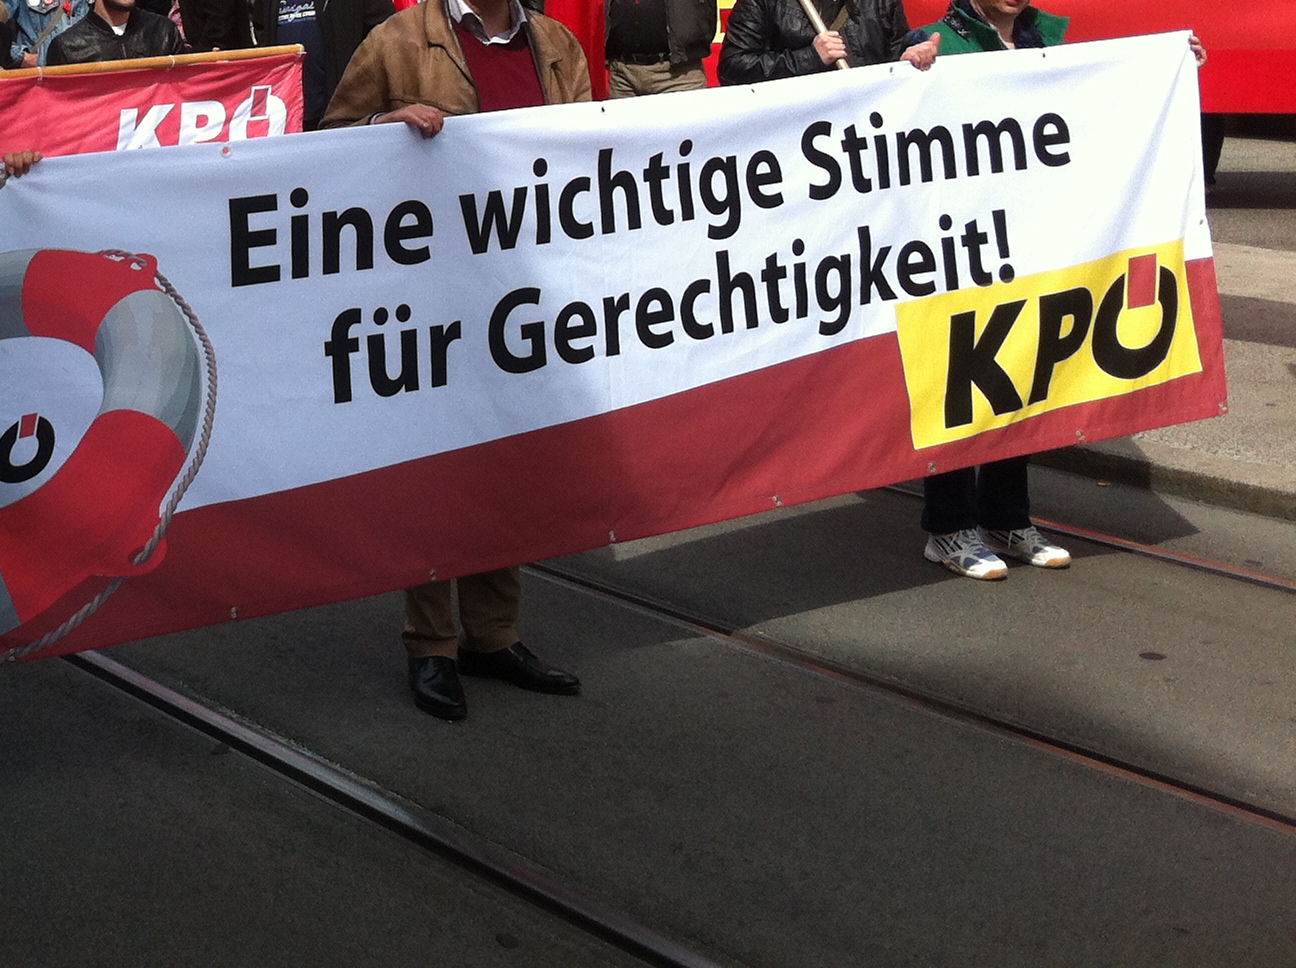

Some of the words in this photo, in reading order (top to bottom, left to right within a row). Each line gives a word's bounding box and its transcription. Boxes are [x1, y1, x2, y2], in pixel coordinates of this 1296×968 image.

[116, 84, 287, 151] KPÖ
[228, 187, 434, 288] Eine
[458, 148, 784, 255] wichtige
[801, 111, 1071, 201] Stimme
[324, 303, 462, 404] für
[488, 209, 1015, 374] Gerechtigkeit!
[944, 253, 1179, 430] KPÖ
